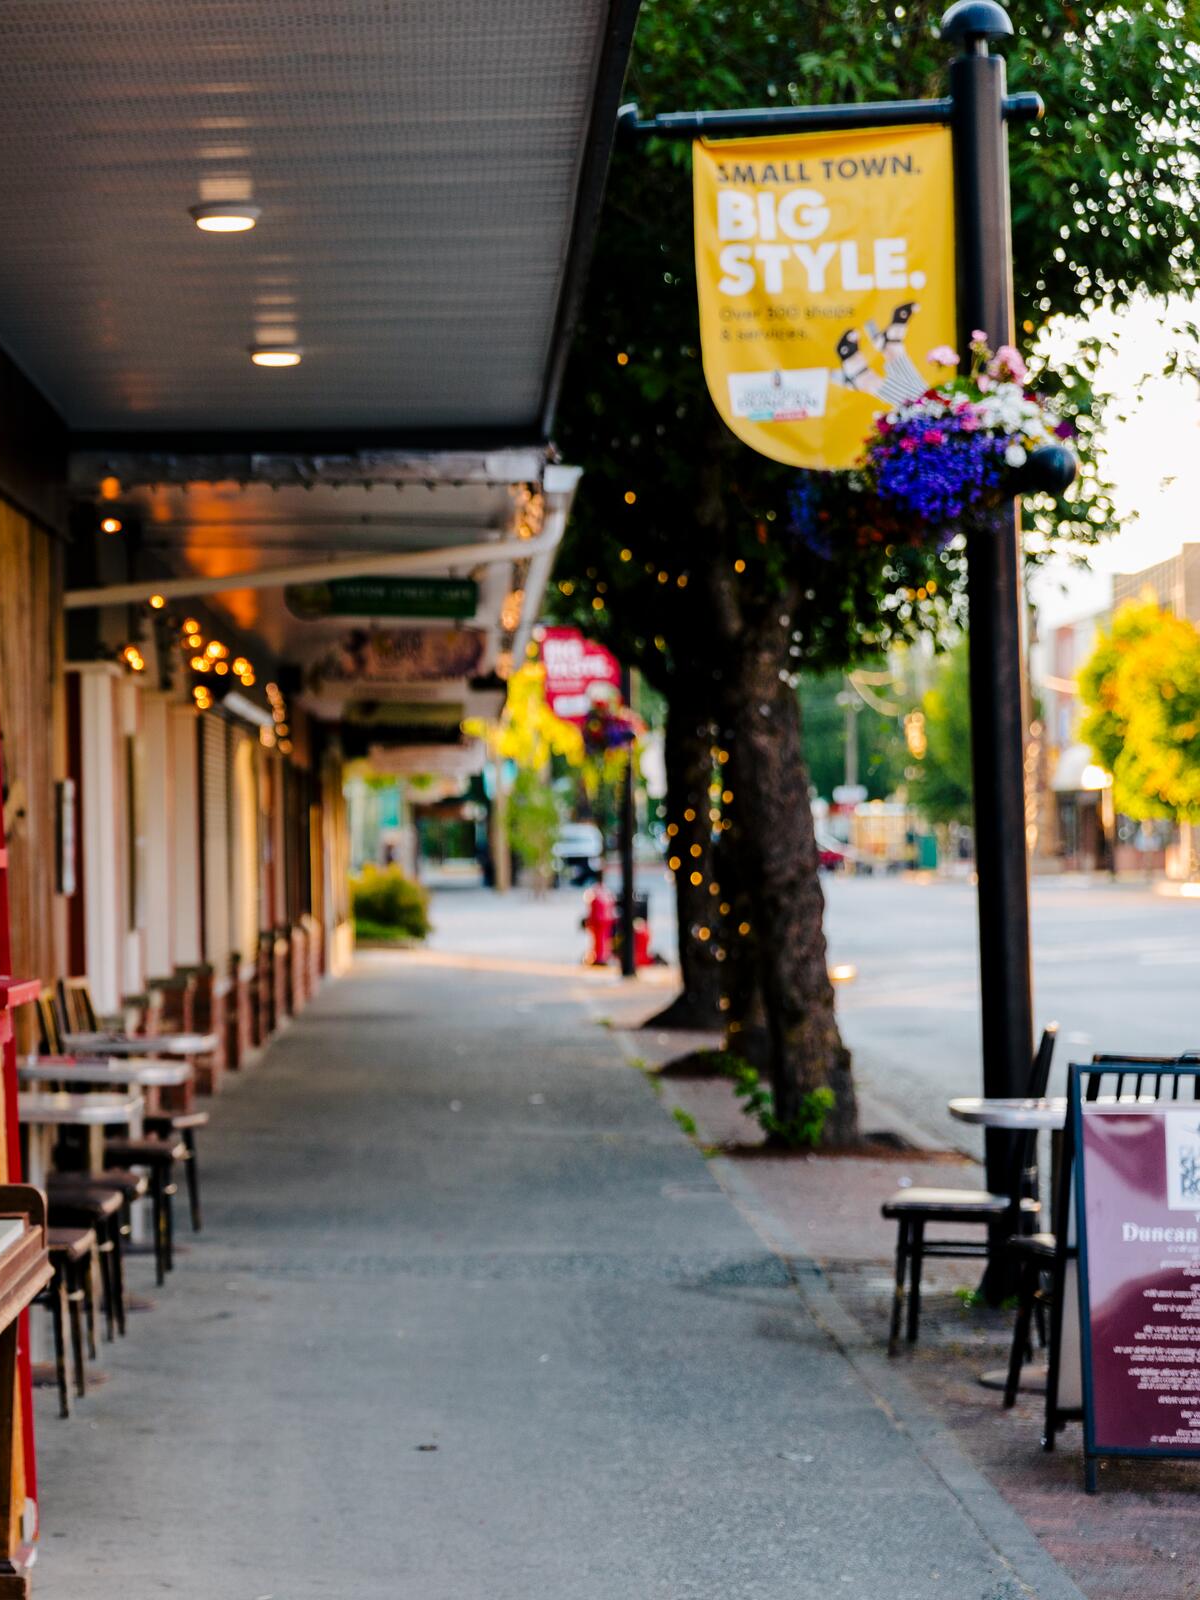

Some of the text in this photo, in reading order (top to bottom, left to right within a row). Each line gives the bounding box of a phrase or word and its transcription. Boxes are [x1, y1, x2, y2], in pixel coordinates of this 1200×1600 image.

[717, 154, 922, 185] SMALL TOWN.
[716, 188, 831, 241] BIG
[717, 237, 927, 297] STYLE.
[719, 307, 761, 322] Over
[1122, 1223, 1198, 1243] Duncan
